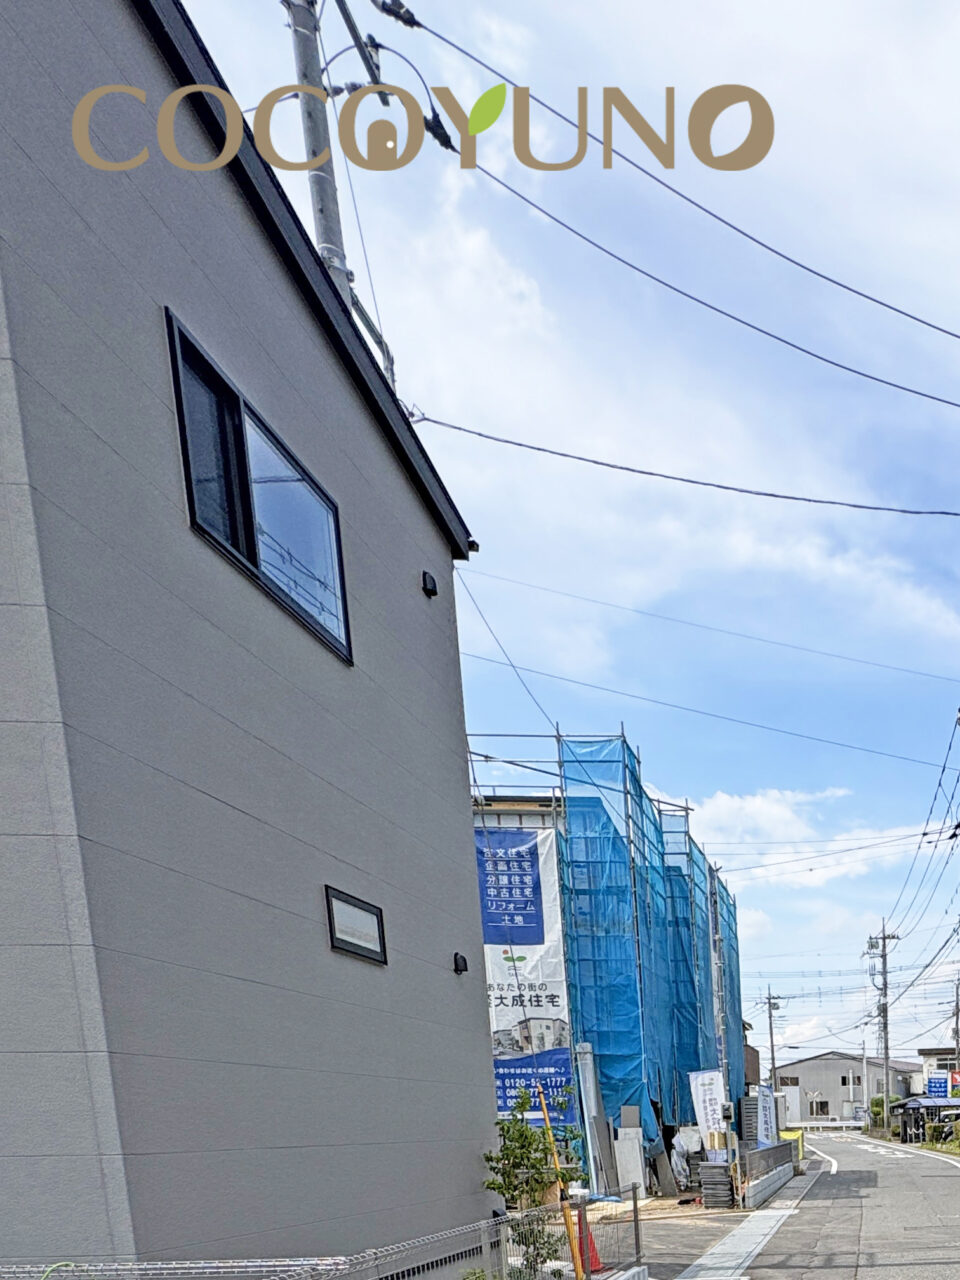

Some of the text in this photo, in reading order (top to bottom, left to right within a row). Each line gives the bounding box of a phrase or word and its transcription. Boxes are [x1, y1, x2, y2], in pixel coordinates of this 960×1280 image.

[485, 861, 532, 872] 企画住宅
[486, 874, 533, 885] 分譲住宅
[487, 887, 534, 898] 中古住宅
[488, 901, 536, 911] リフォーム
[501, 914, 524, 925] 土地
[487, 982, 548, 992] あなたの街の
